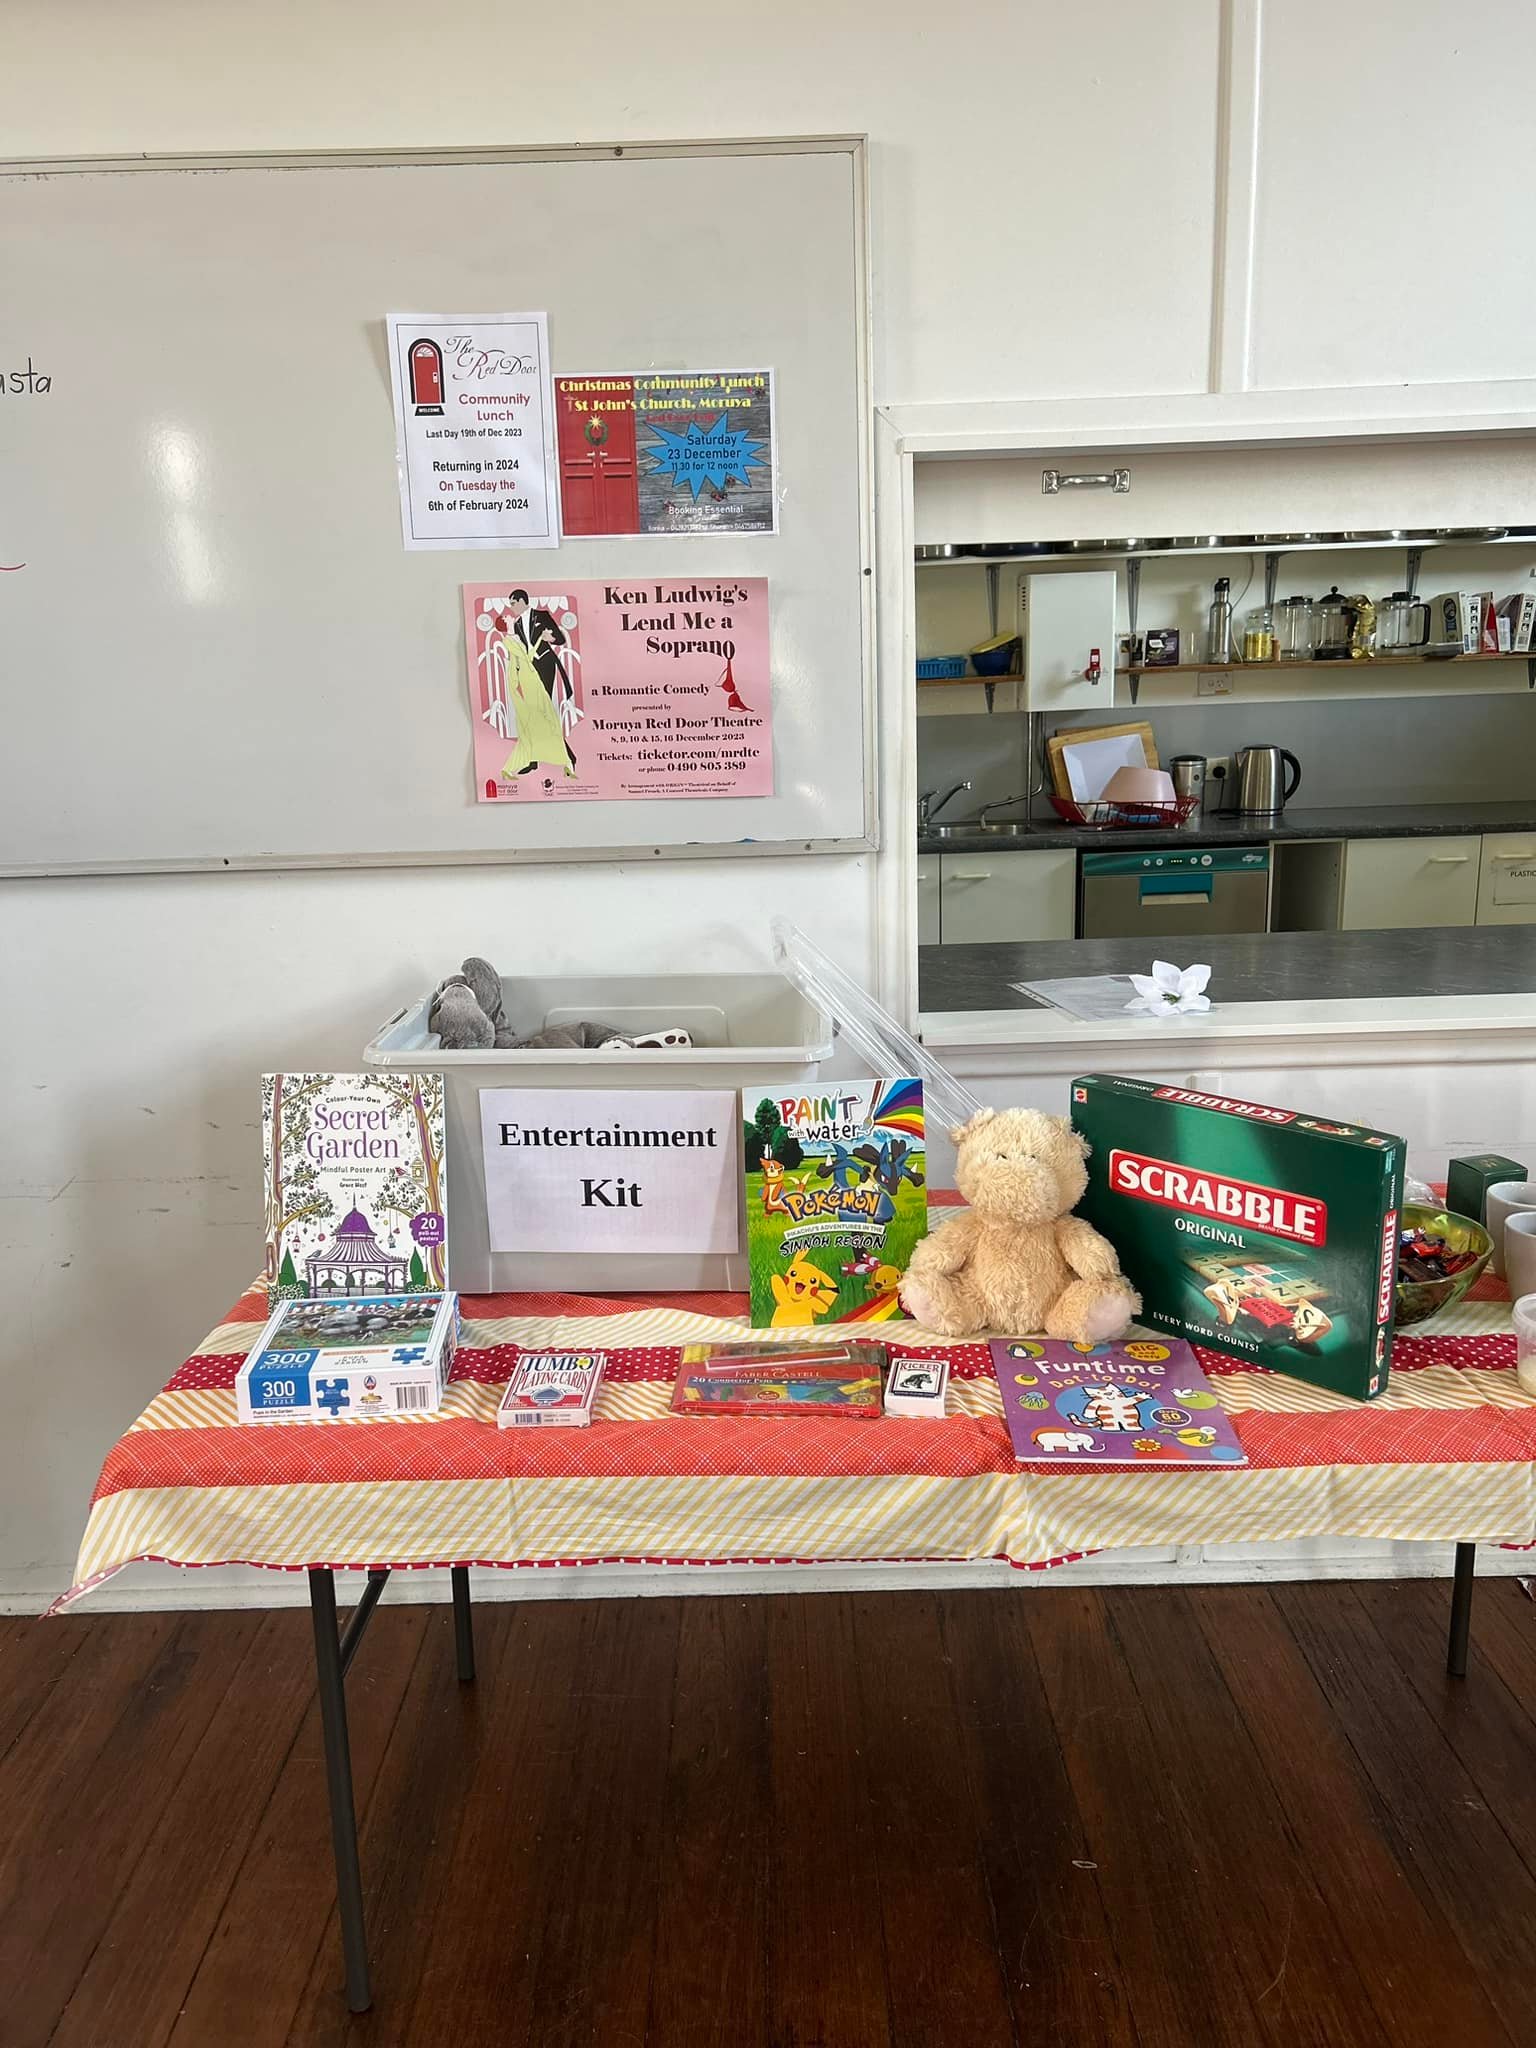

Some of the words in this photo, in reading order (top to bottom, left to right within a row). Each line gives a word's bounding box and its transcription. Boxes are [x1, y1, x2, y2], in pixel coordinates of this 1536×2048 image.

[444, 336, 474, 354] The
[452, 349, 505, 380] Red
[499, 356, 537, 375] Door
[560, 380, 632, 392] Christmas
[634, 376, 718, 390] Community
[720, 376, 764, 389] Lunch
[459, 393, 531, 406] Community
[575, 400, 588, 412] St
[591, 400, 637, 412] John's
[640, 399, 696, 410] Church,
[699, 398, 751, 409] Moruya
[477, 410, 514, 421] Lunch
[426, 430, 442, 438] Last
[444, 430, 458, 440] Day
[461, 429, 477, 438] 19th
[478, 428, 486, 437] of
[487, 428, 502, 437] Dec
[504, 428, 522, 437] 2023
[687, 434, 737, 447] Saturday
[668, 448, 681, 460] 23
[684, 448, 742, 460] December
[433, 460, 481, 473] Returning
[484, 460, 493, 470] in
[496, 459, 519, 470] 2024
[671, 462, 690, 470] 11.30
[692, 462, 704, 470] for
[707, 462, 714, 470] 12
[718, 462, 738, 470] noon
[439, 480, 454, 491] On
[458, 480, 497, 492] Tuesday
[500, 479, 516, 490] the
[428, 500, 444, 511] 6th
[446, 500, 457, 510] of
[460, 500, 503, 512] February
[505, 498, 529, 510] 2024
[668, 506, 703, 515] Booking
[704, 504, 744, 514] Essential
[604, 586, 648, 604] Ken
[654, 584, 748, 606] Ludwig's
[621, 612, 675, 631] Lend
[682, 612, 716, 630] Me
[721, 617, 734, 630] a
[646, 636, 736, 660] Soprano
[592, 688, 598, 696] a
[602, 685, 661, 696] Romantic
[664, 684, 710, 696] Comedy
[664, 704, 671, 712] by
[592, 719, 642, 732] Moruya
[646, 718, 671, 730] Red
[676, 718, 709, 729] Door
[710, 716, 763, 728] Theatre
[676, 734, 720, 742] December
[722, 733, 745, 741] 2023
[597, 752, 633, 761] Tickets:
[646, 766, 666, 774] phone
[667, 762, 698, 772] 0490
[700, 762, 722, 771] 805
[724, 761, 746, 770] 389
[778, 1095, 859, 1126] PAINT
[1158, 1088, 1290, 1122] SCRABBLE
[314, 1104, 390, 1130] Secret
[498, 1124, 718, 1147] Entertainment
[806, 1122, 860, 1140] water
[307, 1131, 400, 1166] Garden
[580, 1178, 643, 1207] Kit
[1117, 1159, 1318, 1238] SCRABBLE
[421, 1218, 436, 1230] 20
[787, 1225, 820, 1238] PIKACHU'S
[1174, 1217, 1246, 1249] ORIGINAL
[780, 1234, 830, 1256] SINNOH
[834, 1234, 886, 1249] REGION
[1380, 1212, 1396, 1319] SCRABBLE
[1153, 1311, 1182, 1326] EVERY
[1185, 1320, 1214, 1338] WORD
[1217, 1328, 1259, 1352] COUNTS!
[1130, 1344, 1160, 1352] BIG
[264, 1352, 312, 1364] 300
[522, 1356, 594, 1372] JUMBO
[900, 1362, 940, 1371] KICKER
[1034, 1360, 1166, 1375] Funtime
[520, 1370, 558, 1390] PLAYING
[560, 1371, 591, 1392] CARDS
[692, 1376, 706, 1384] 20
[1048, 1374, 1161, 1390] Dot-to-Dot
[262, 1380, 295, 1398] 300
